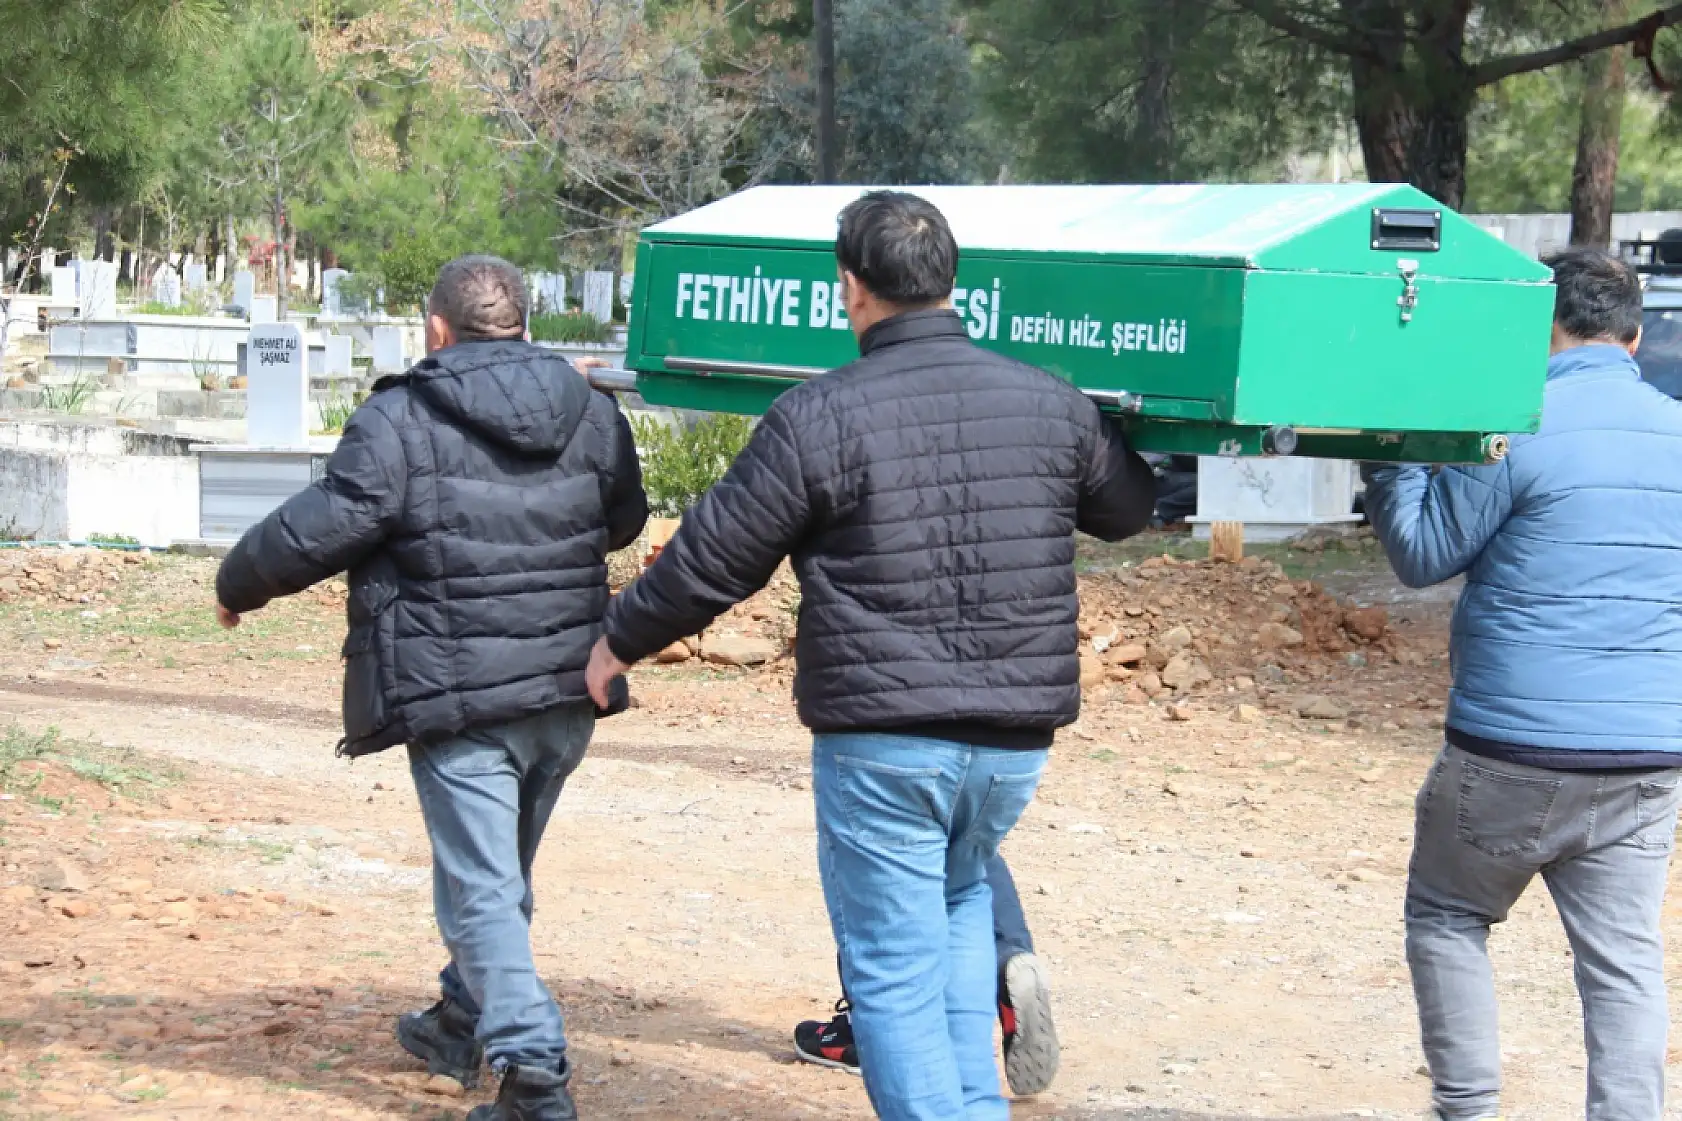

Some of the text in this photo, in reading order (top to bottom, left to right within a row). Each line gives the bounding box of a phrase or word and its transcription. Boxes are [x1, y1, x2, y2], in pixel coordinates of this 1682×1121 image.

[676, 265, 801, 327] FETHİYE
[1010, 311, 1064, 345] DEFİN
[1069, 313, 1105, 348] HİZ.
[1111, 318, 1187, 356] ŞEFLİĞİ
[253, 337, 284, 349] MEHMET
